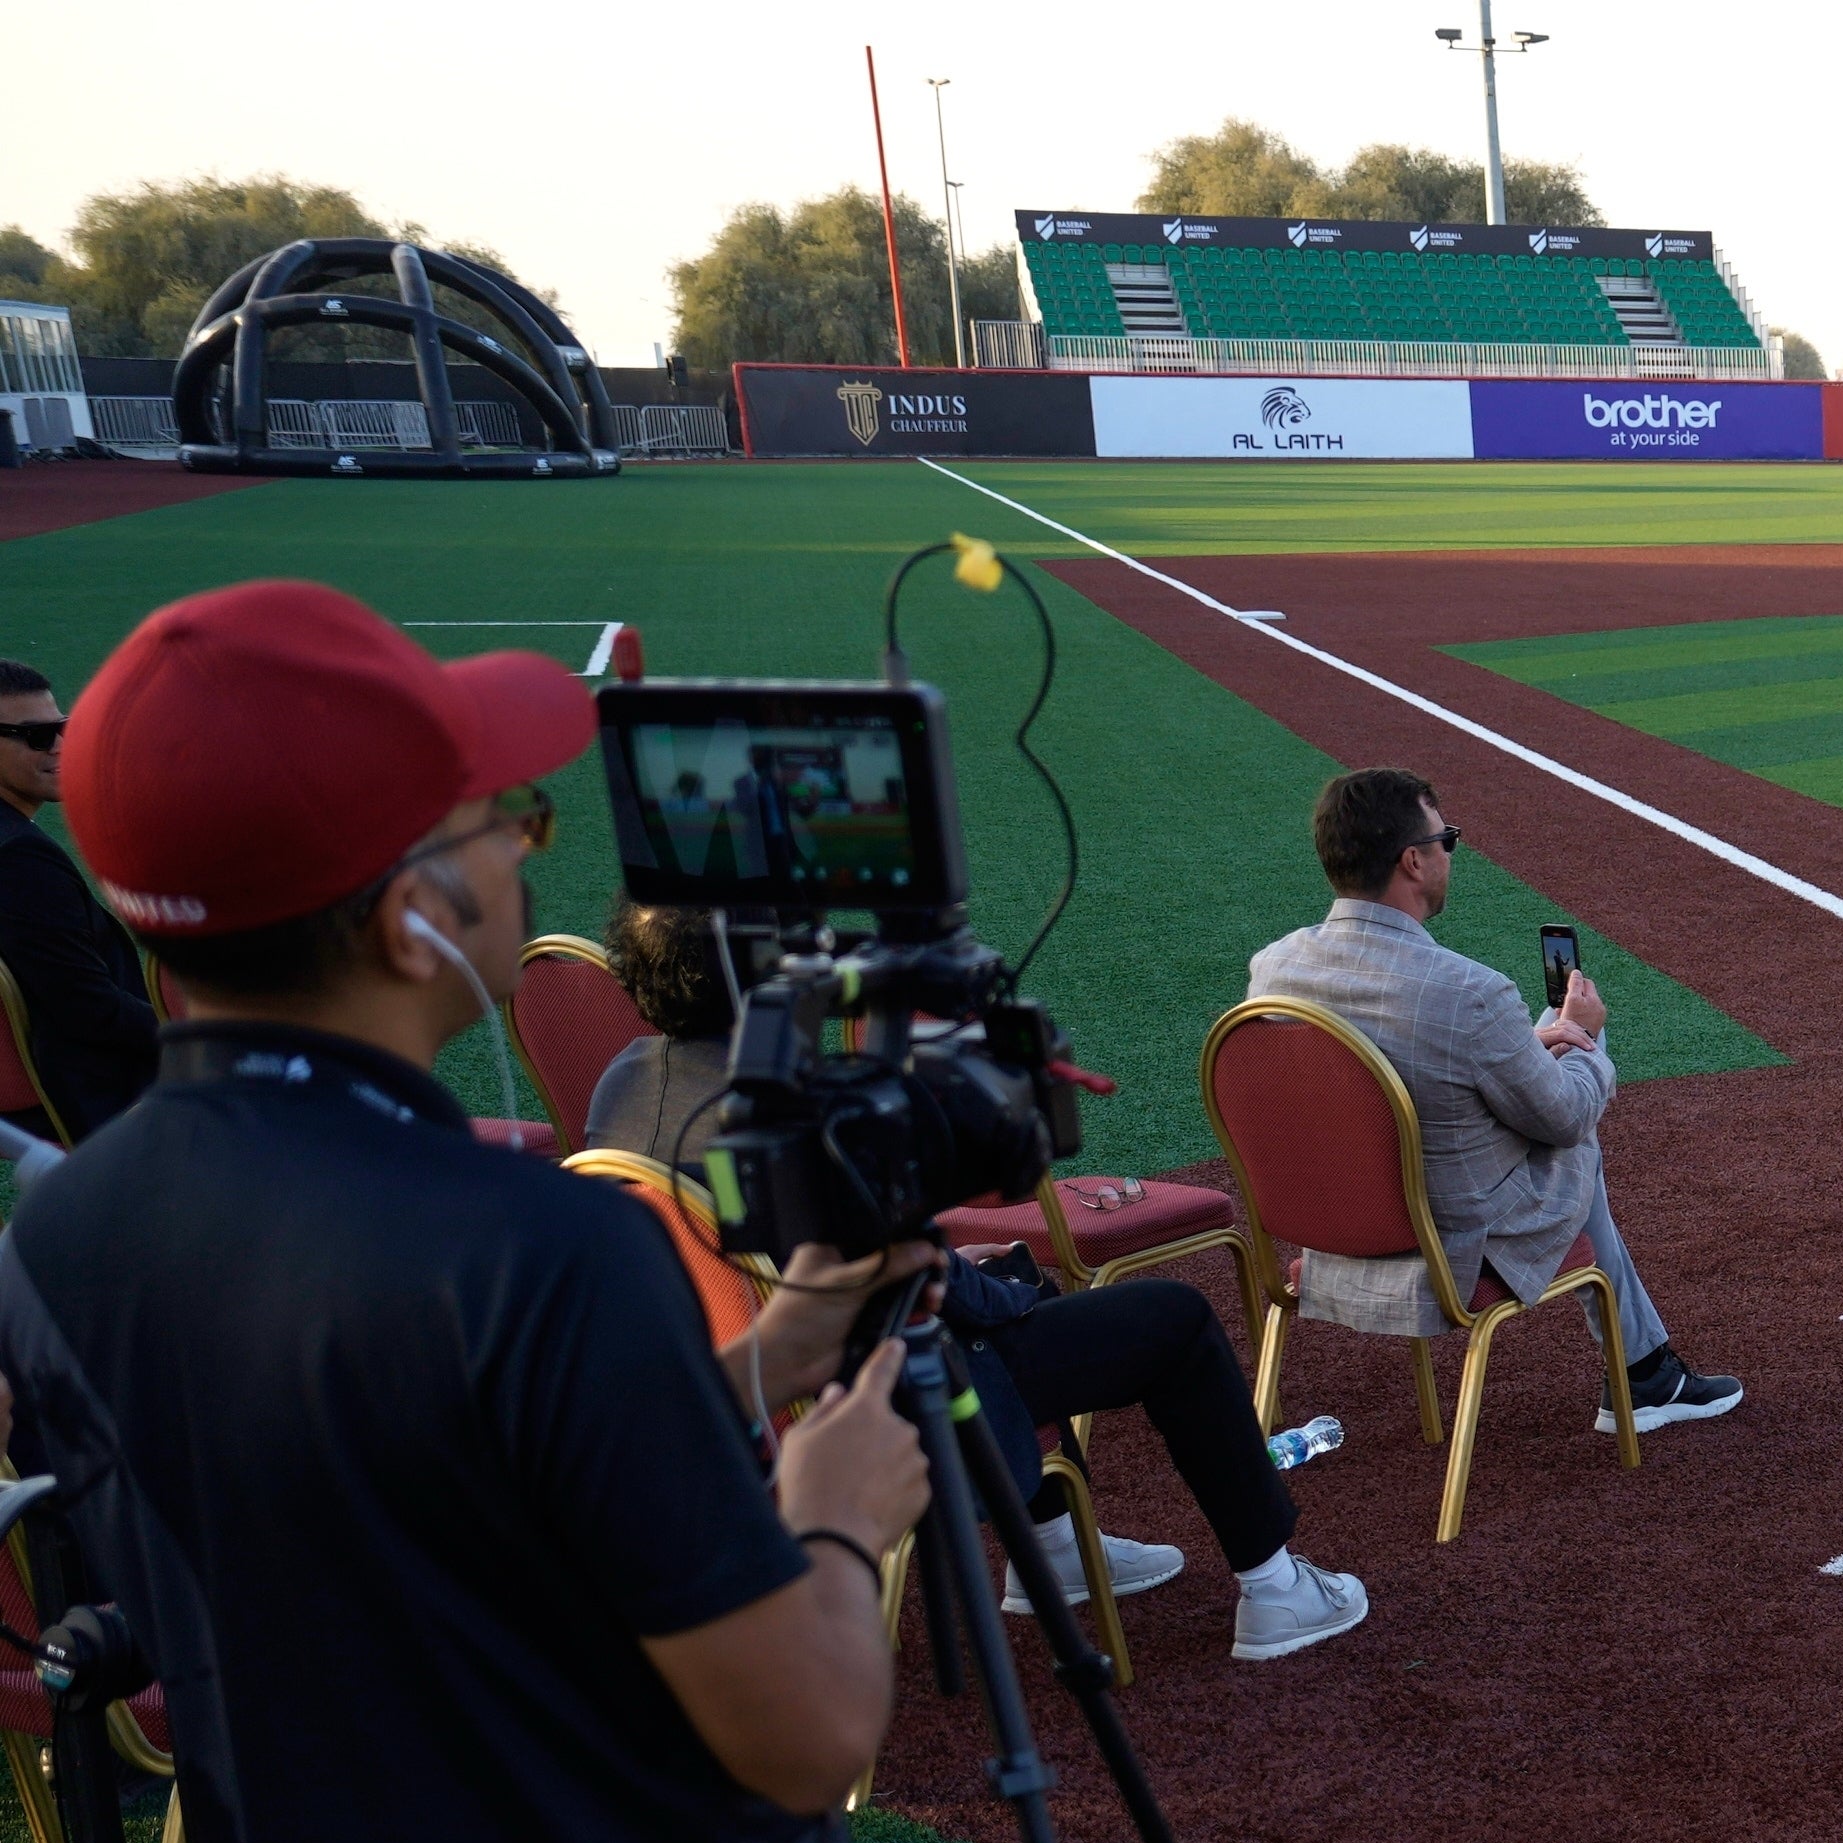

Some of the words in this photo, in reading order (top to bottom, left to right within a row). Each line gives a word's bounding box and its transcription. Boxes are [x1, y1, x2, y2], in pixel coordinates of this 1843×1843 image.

[1057, 220, 1092, 229] BASEBALL
[1184, 224, 1219, 233] BASEBALL
[1057, 228, 1083, 236] UNITED
[1308, 228, 1342, 236] BASEBALL
[1430, 232, 1462, 240] BASEBALL
[1308, 235, 1334, 243] UNITED
[1549, 236, 1581, 244] BASEBALL
[1664, 239, 1695, 247] BASEBALL
[888, 395, 967, 416] INDUS
[1584, 393, 1722, 428] brother
[891, 420, 968, 433] CHAUFFEUR
[1233, 434, 1263, 449] AL
[1275, 434, 1343, 450] LAITH
[1610, 431, 1626, 446] at
[1629, 433, 1666, 449] your
[1668, 430, 1700, 446] side
